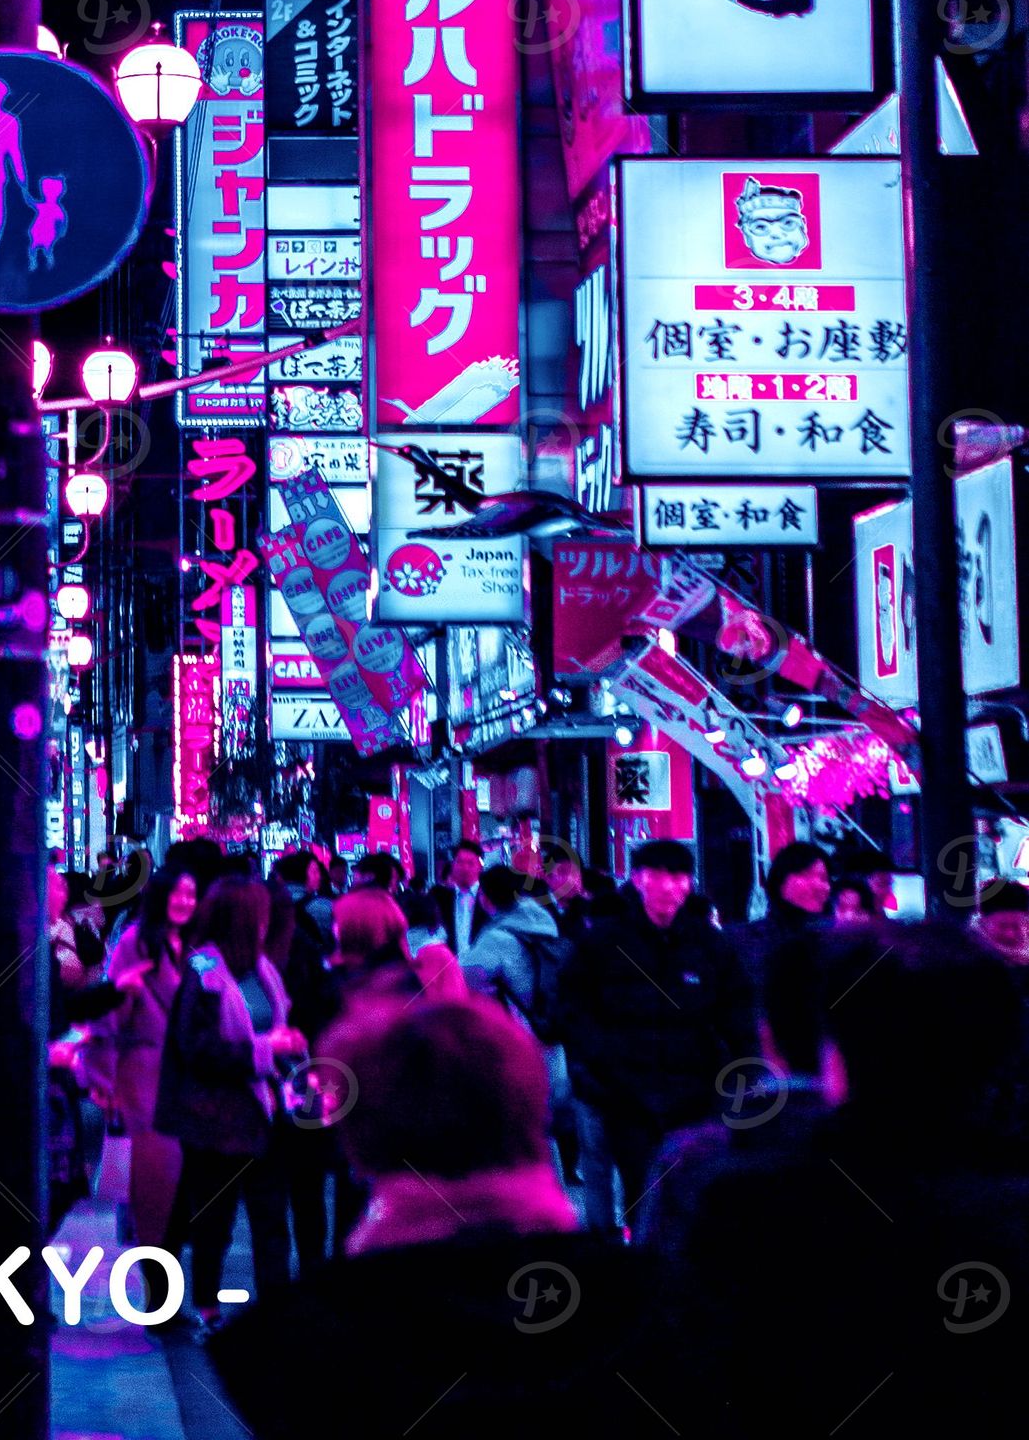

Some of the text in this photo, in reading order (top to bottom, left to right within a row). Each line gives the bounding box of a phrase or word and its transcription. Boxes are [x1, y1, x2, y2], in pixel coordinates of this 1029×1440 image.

[293, 19, 320, 127] &コミック
[644, 317, 908, 363] 個室・お座敷
[675, 406, 896, 455] 寿司・和食
[654, 497, 808, 533] 個室・和食
[559, 551, 658, 578] ツルハ
[482, 581, 520, 598] Shop
